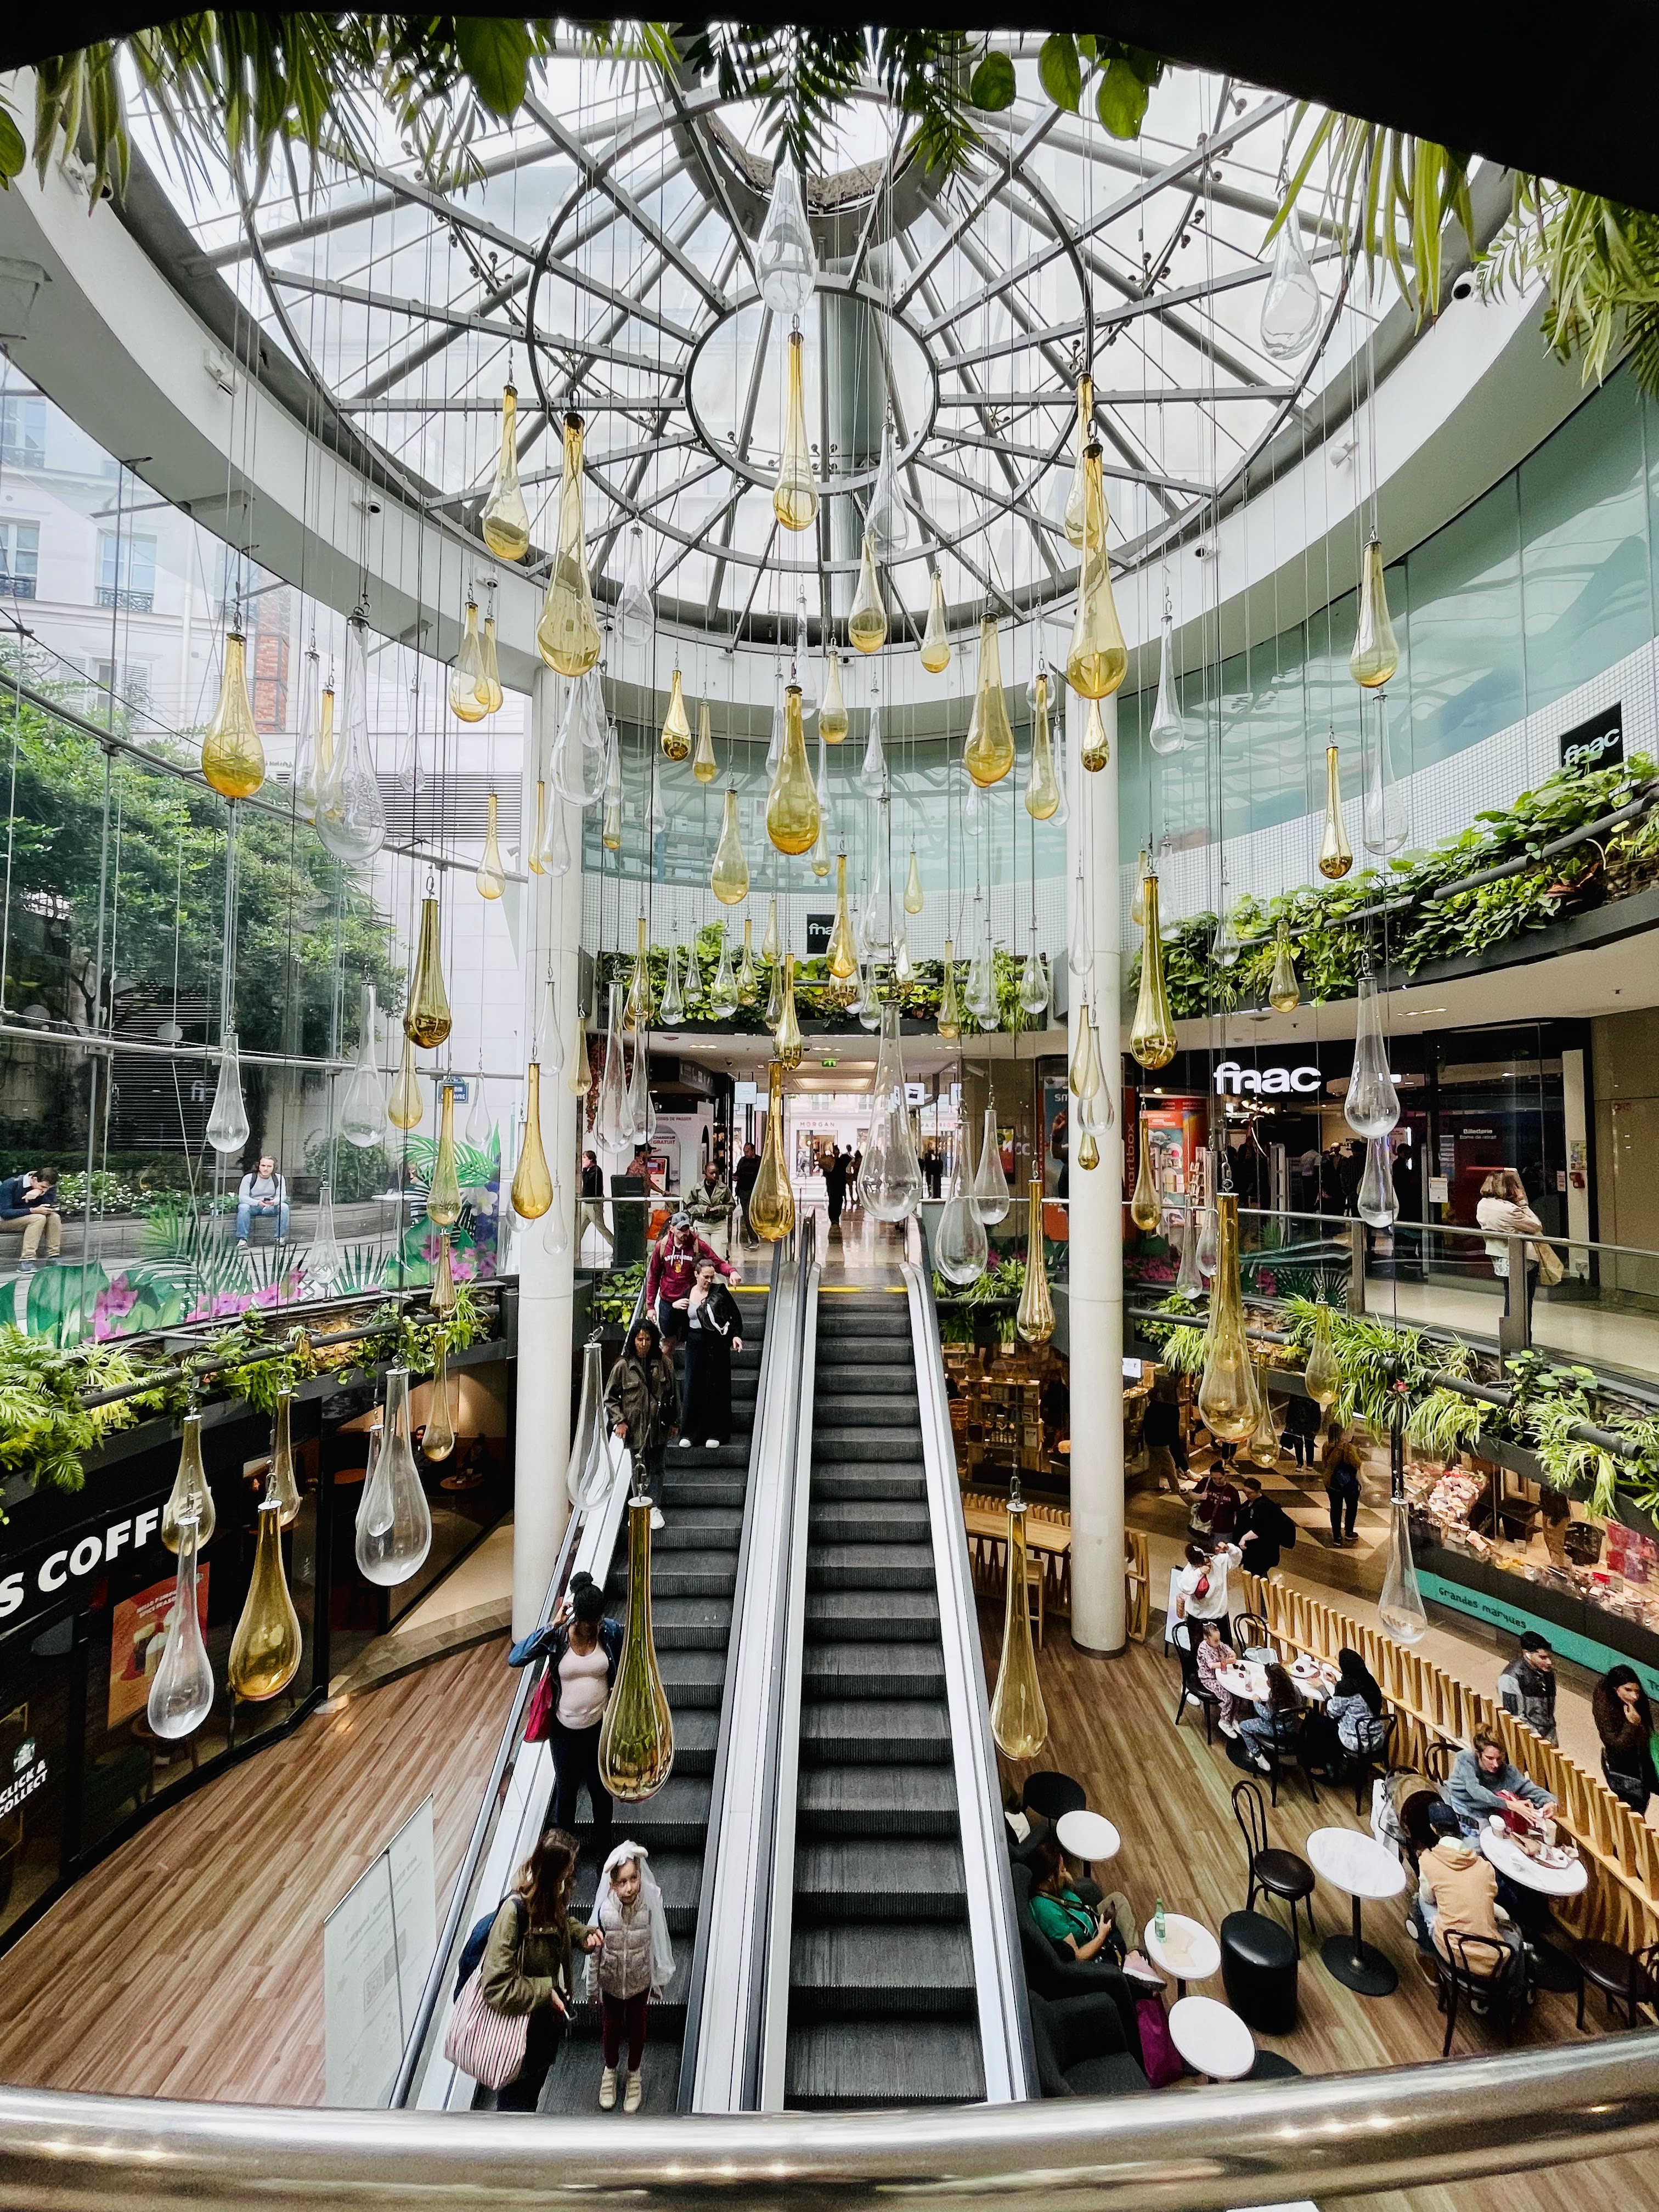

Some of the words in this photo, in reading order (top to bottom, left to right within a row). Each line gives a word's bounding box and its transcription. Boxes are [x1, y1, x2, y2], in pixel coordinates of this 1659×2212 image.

[809, 923, 833, 935] fna
[1213, 1062, 1321, 1094] fnac
[1126, 1123, 1135, 1198] martbox
[1438, 1587, 1479, 1609] Grandes
[1482, 1605, 1526, 1629] marques
[0, 1767, 35, 1804] CLICK
